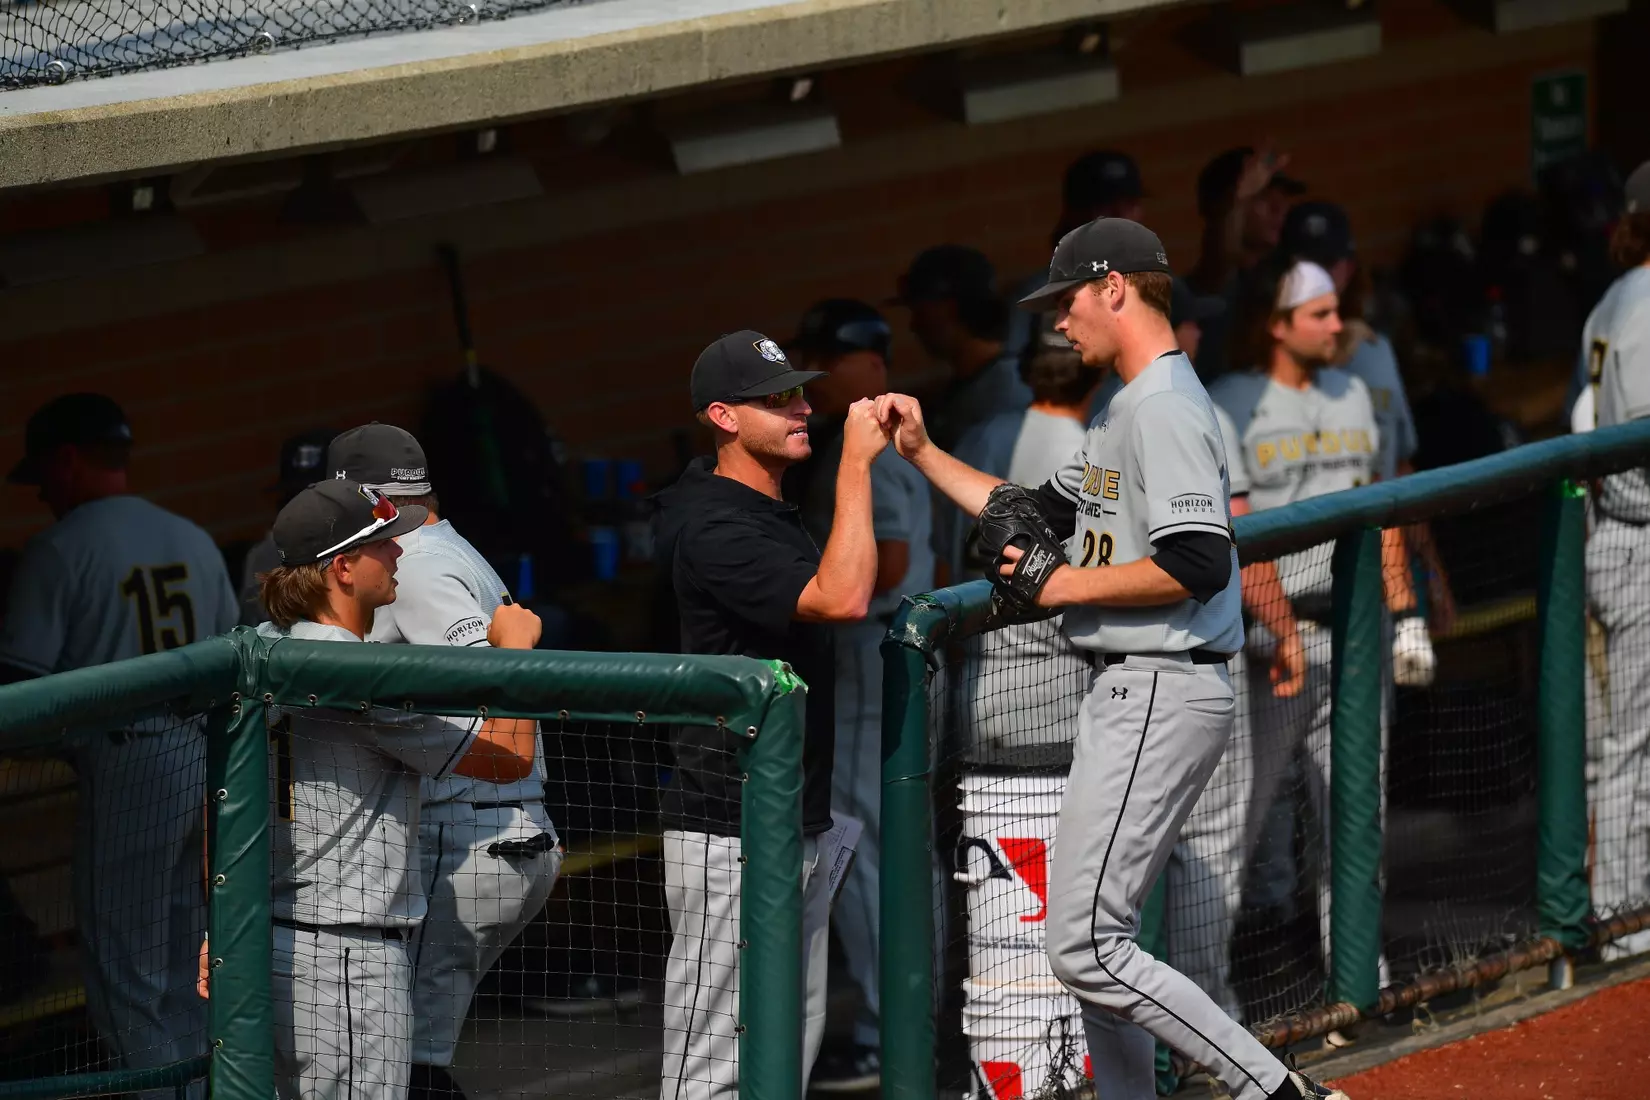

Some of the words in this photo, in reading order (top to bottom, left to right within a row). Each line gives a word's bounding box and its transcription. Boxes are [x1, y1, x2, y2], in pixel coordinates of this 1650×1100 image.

[1171, 499, 1213, 509] HORIZON
[1080, 527, 1115, 567] 28
[119, 562, 196, 654] 15
[446, 620, 484, 642] HORIZON
